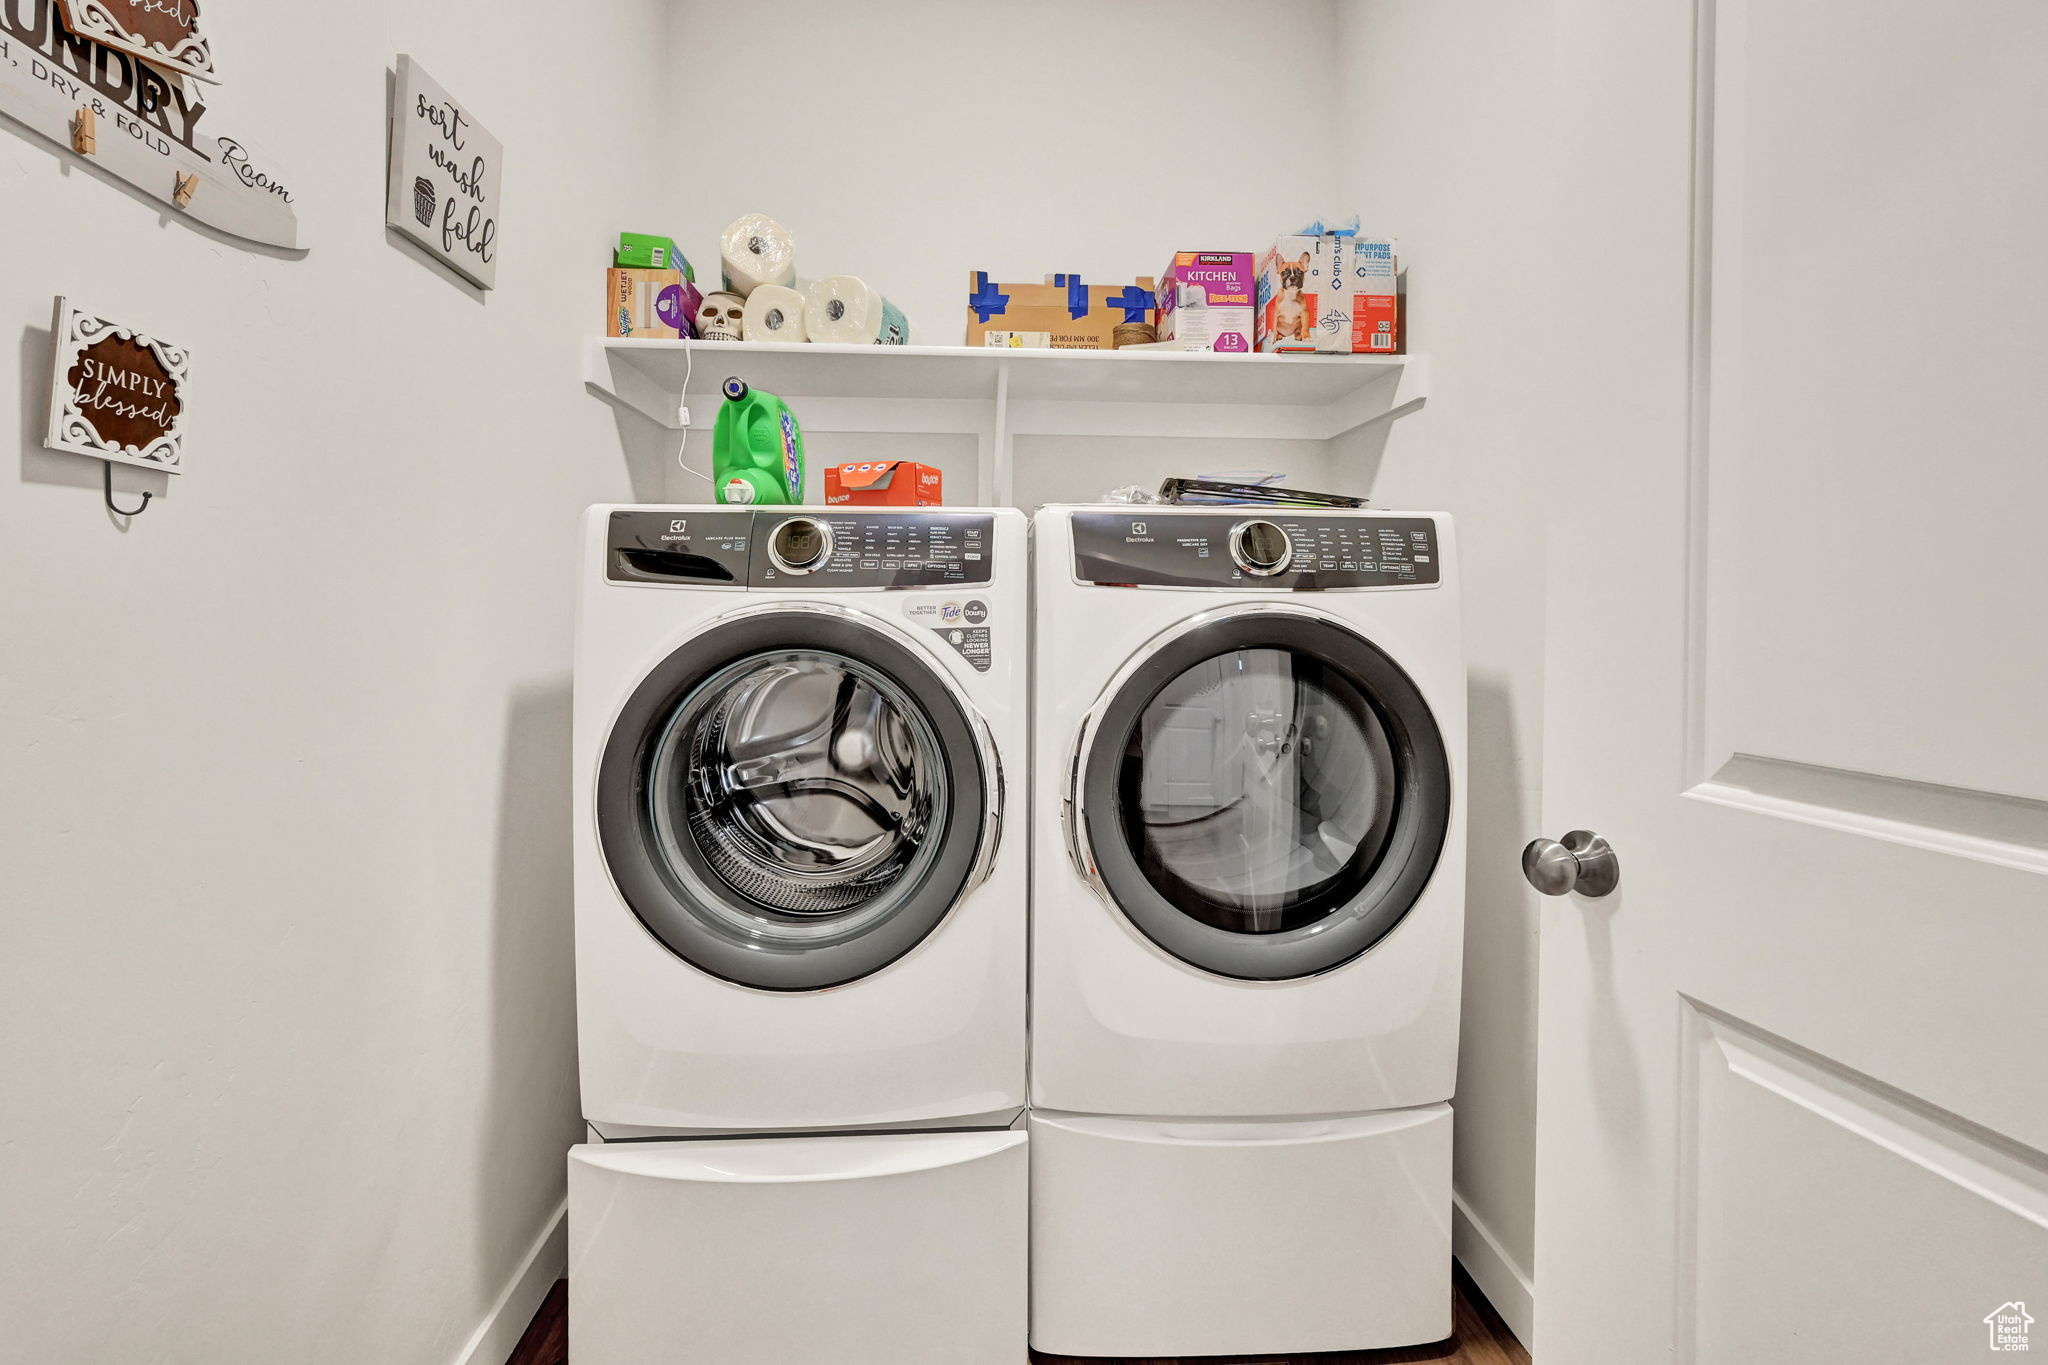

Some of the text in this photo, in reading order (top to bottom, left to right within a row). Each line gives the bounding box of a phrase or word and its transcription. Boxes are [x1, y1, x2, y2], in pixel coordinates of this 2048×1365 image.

[32, 58, 80, 100] DRY
[91, 98, 105, 118] &
[117, 113, 170, 156] FOLD
[416, 93, 469, 151] sort
[217, 136, 294, 204] Room
[429, 143, 486, 203] wash
[442, 197, 495, 263] fold
[1333, 256, 1342, 277] club
[1373, 251, 1391, 260] PADS
[1187, 271, 1237, 282] KITCHEN
[619, 270, 633, 336] Swiffer WETJET
[1224, 334, 1238, 346] 13
[82, 358, 167, 399] SIMPLY
[73, 377, 173, 428] blessed
[827, 493, 850, 504] bounce
[921, 472, 939, 485] bounce
[942, 606, 961, 620] Tide
